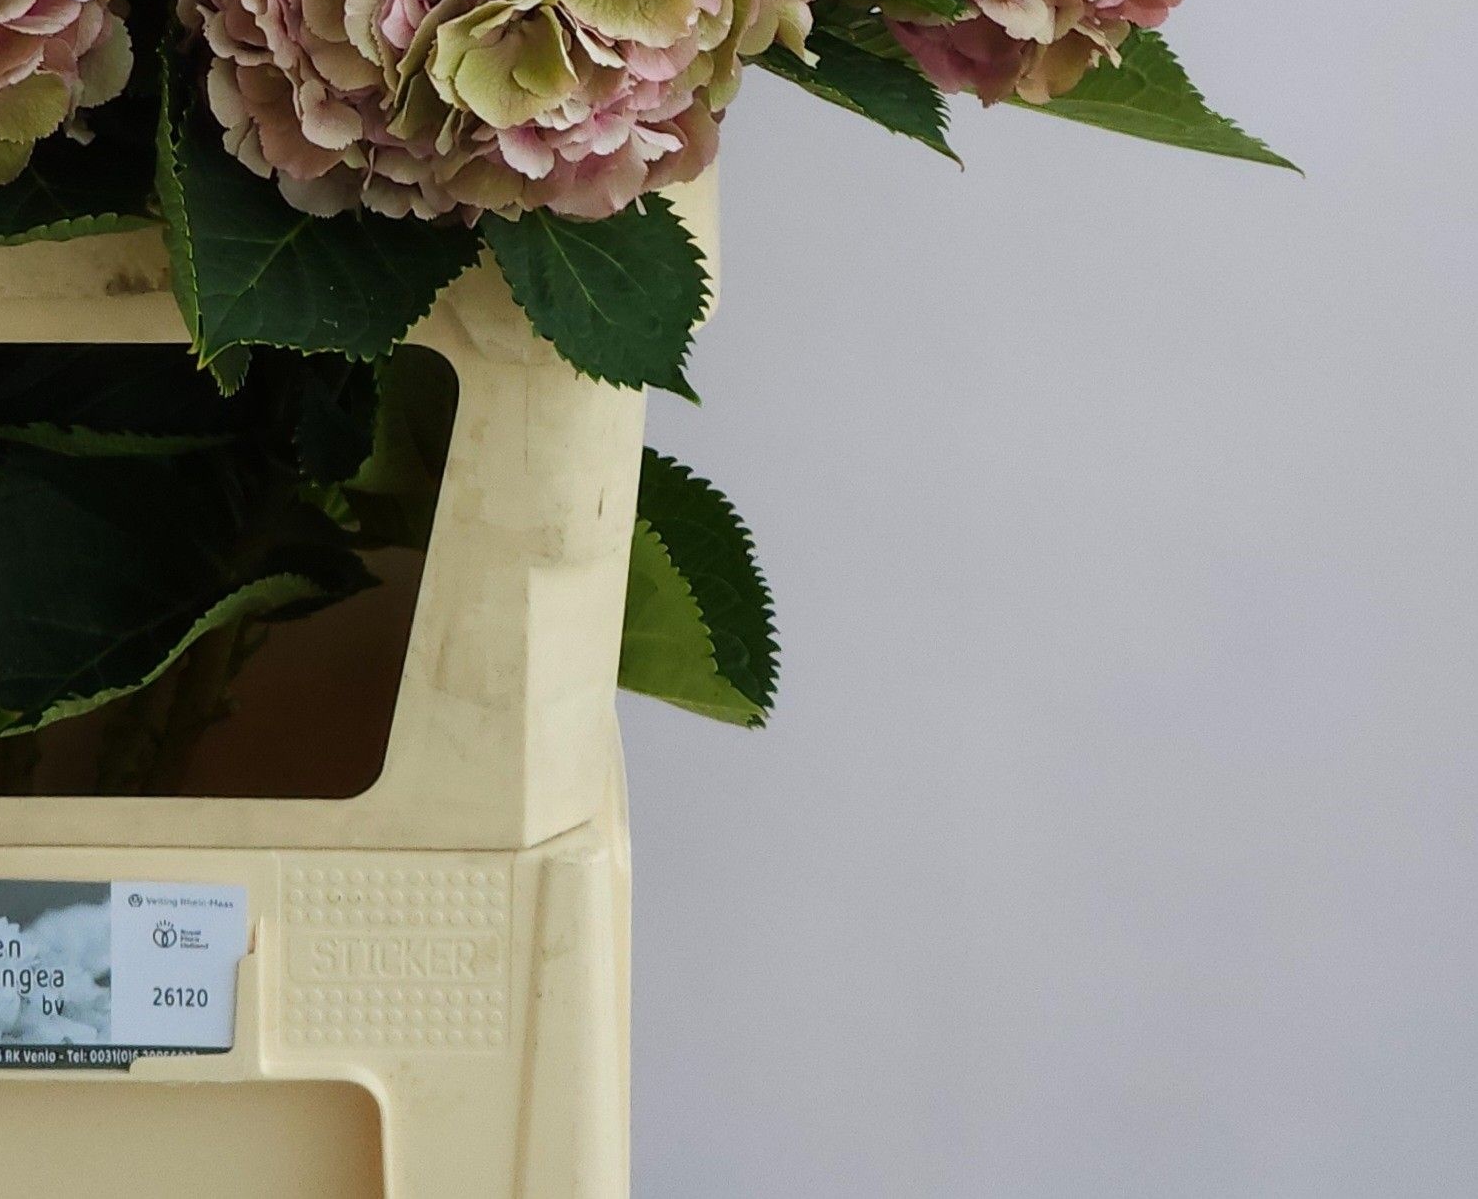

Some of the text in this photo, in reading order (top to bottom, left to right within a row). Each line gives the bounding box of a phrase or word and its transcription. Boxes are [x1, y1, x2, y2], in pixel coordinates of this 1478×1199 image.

[312, 937, 476, 978] STICKER
[41, 995, 65, 1015] bv
[153, 987, 209, 1008] 26120
[5, 1049, 20, 1064] RK
[23, 1049, 57, 1064] Venlo
[67, 1049, 88, 1064] Tel:
